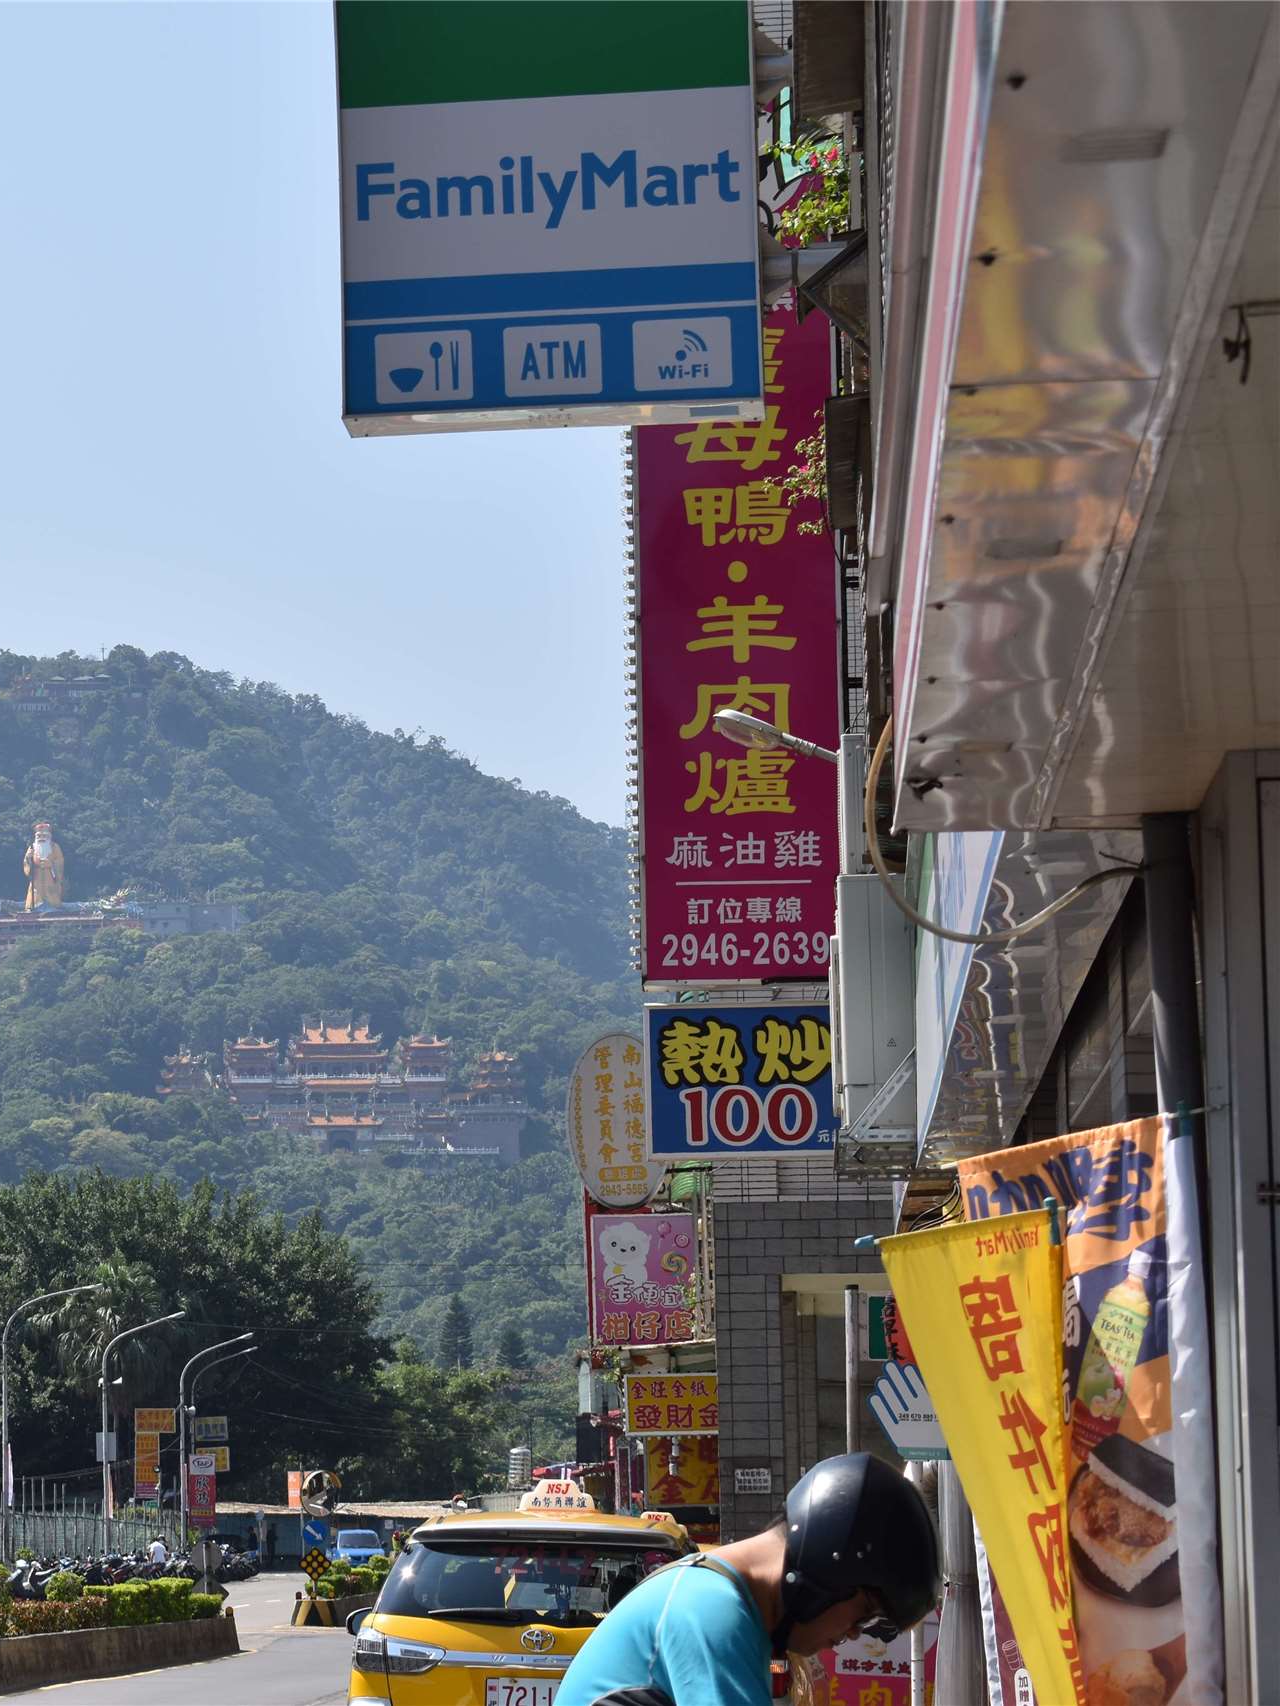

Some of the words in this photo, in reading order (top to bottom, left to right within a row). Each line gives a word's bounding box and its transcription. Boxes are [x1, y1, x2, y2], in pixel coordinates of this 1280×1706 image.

[356, 148, 741, 230] FamilyMart
[521, 339, 587, 382] ATM
[658, 363, 710, 380] Wi-Fi
[665, 831, 823, 869] 麻油雞
[687, 897, 803, 925] 訂位專線
[662, 931, 830, 967] 2946-2639
[680, 1084, 817, 1147] 100
[602, 1311, 694, 1341] 柑仔店
[547, 1483, 571, 1495] NSJ
